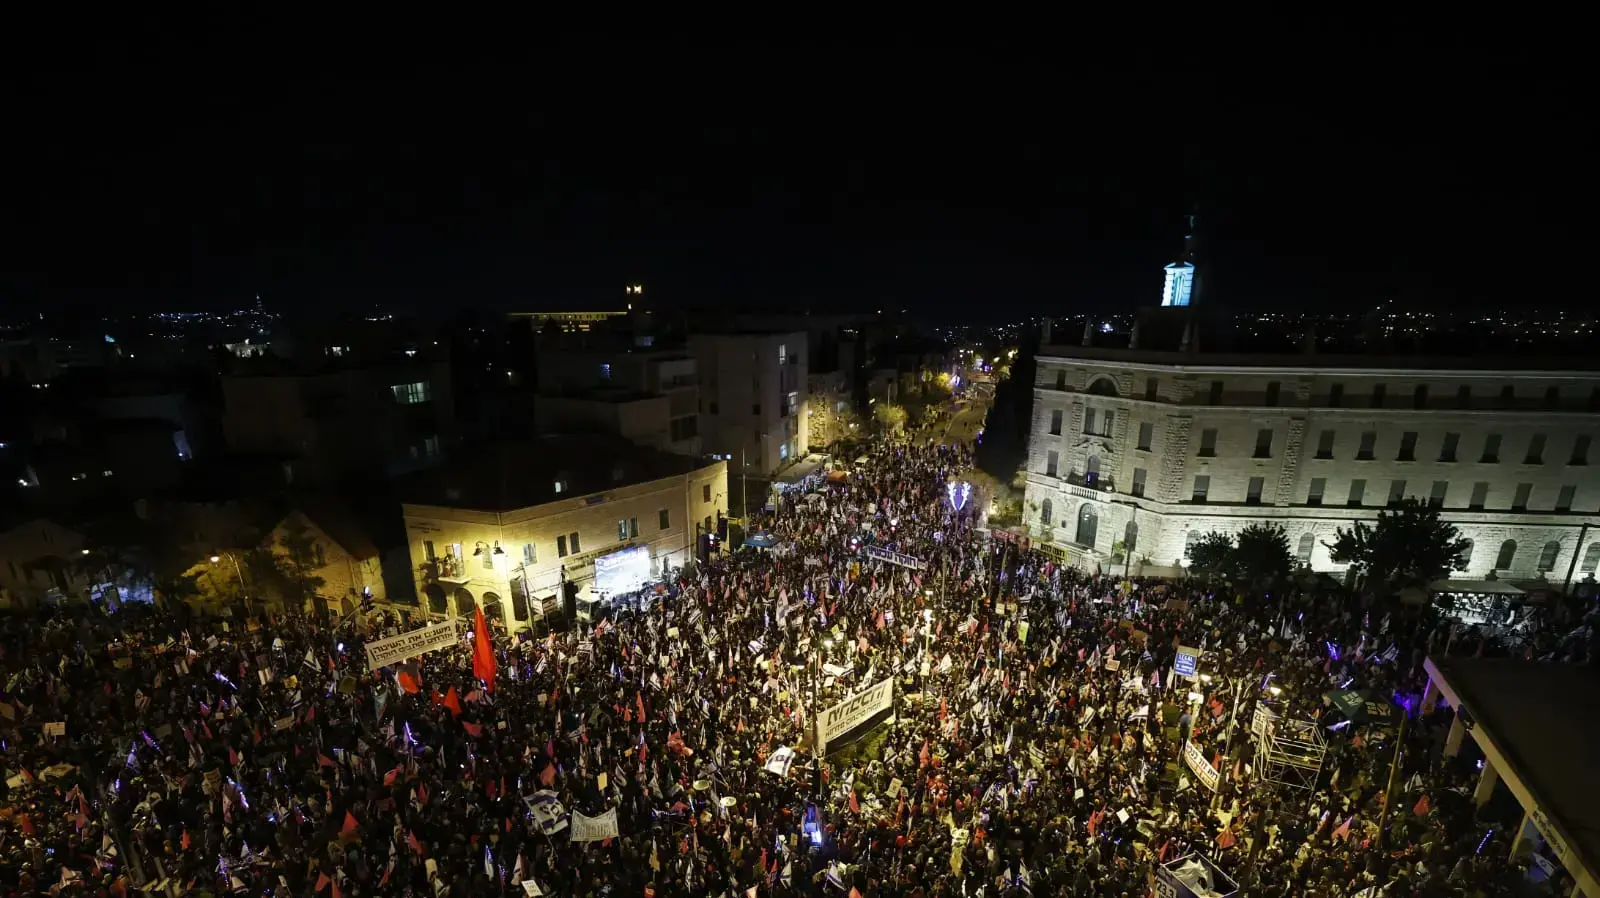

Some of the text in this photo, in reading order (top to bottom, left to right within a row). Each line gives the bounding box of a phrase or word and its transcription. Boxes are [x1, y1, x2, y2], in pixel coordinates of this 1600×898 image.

[895, 552, 916, 567] חוקה
[408, 633, 421, 642] את
[372, 639, 406, 652] השיטה
[376, 633, 453, 661] אזרחים כותבים חוקה
